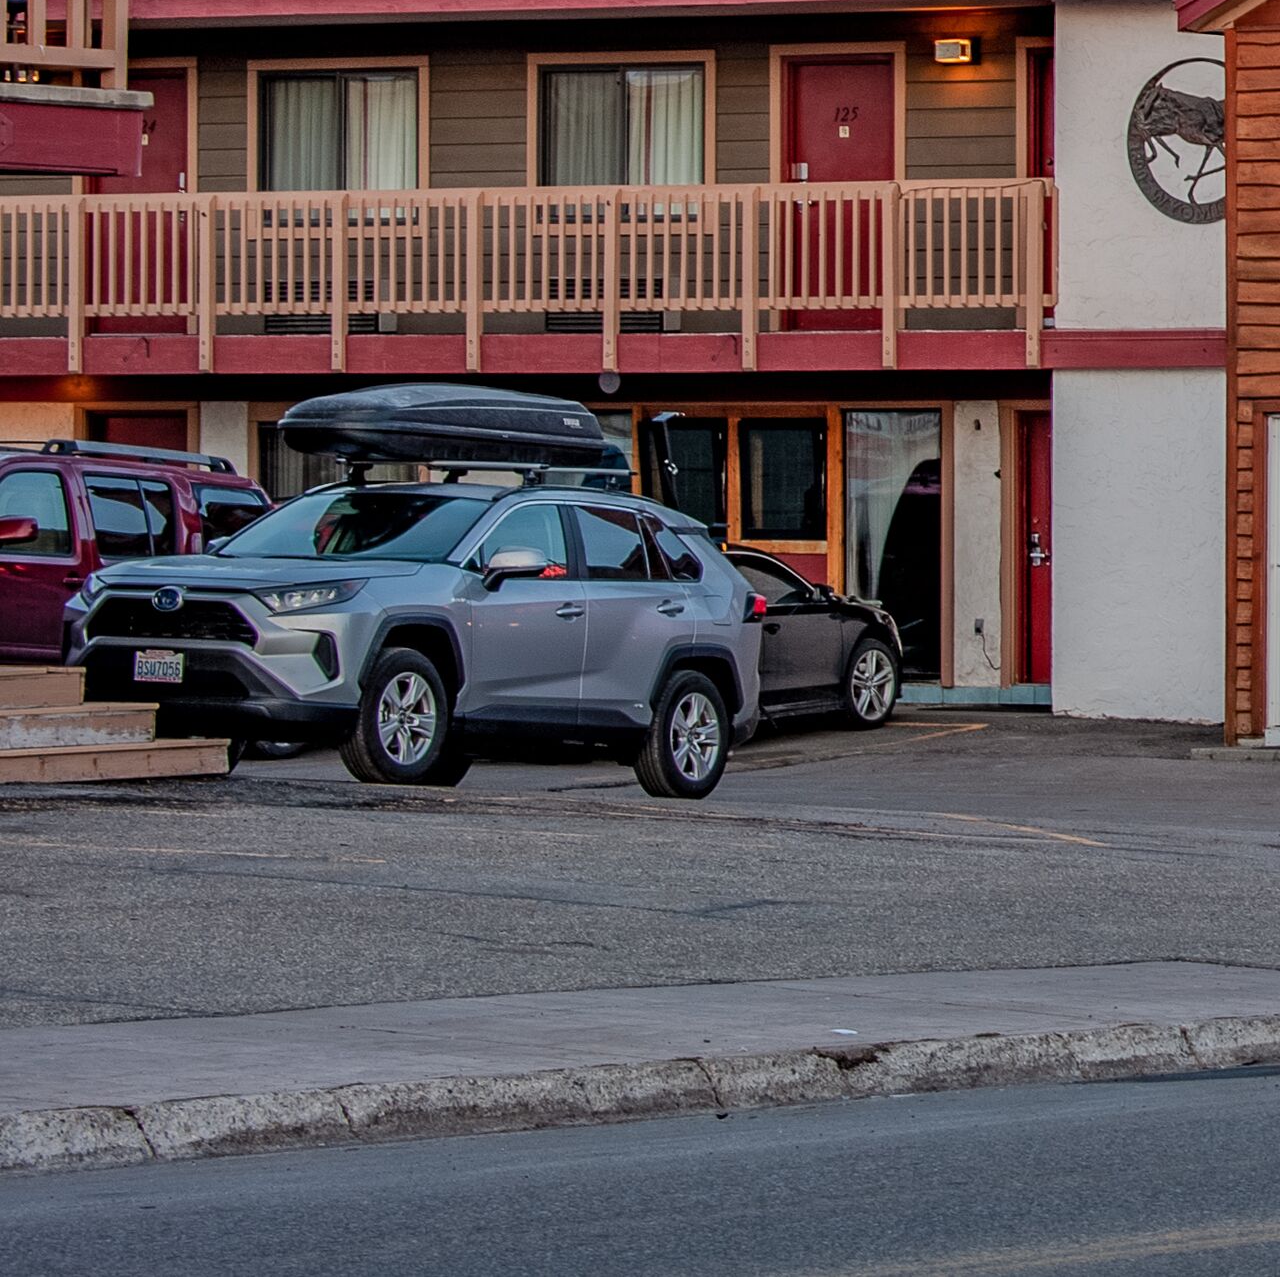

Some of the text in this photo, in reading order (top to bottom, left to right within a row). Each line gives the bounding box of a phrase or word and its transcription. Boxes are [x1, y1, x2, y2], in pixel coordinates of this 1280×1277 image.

[835, 106, 859, 122] 125
[142, 119, 157, 133] 24
[137, 660, 181, 677] BSU7056
